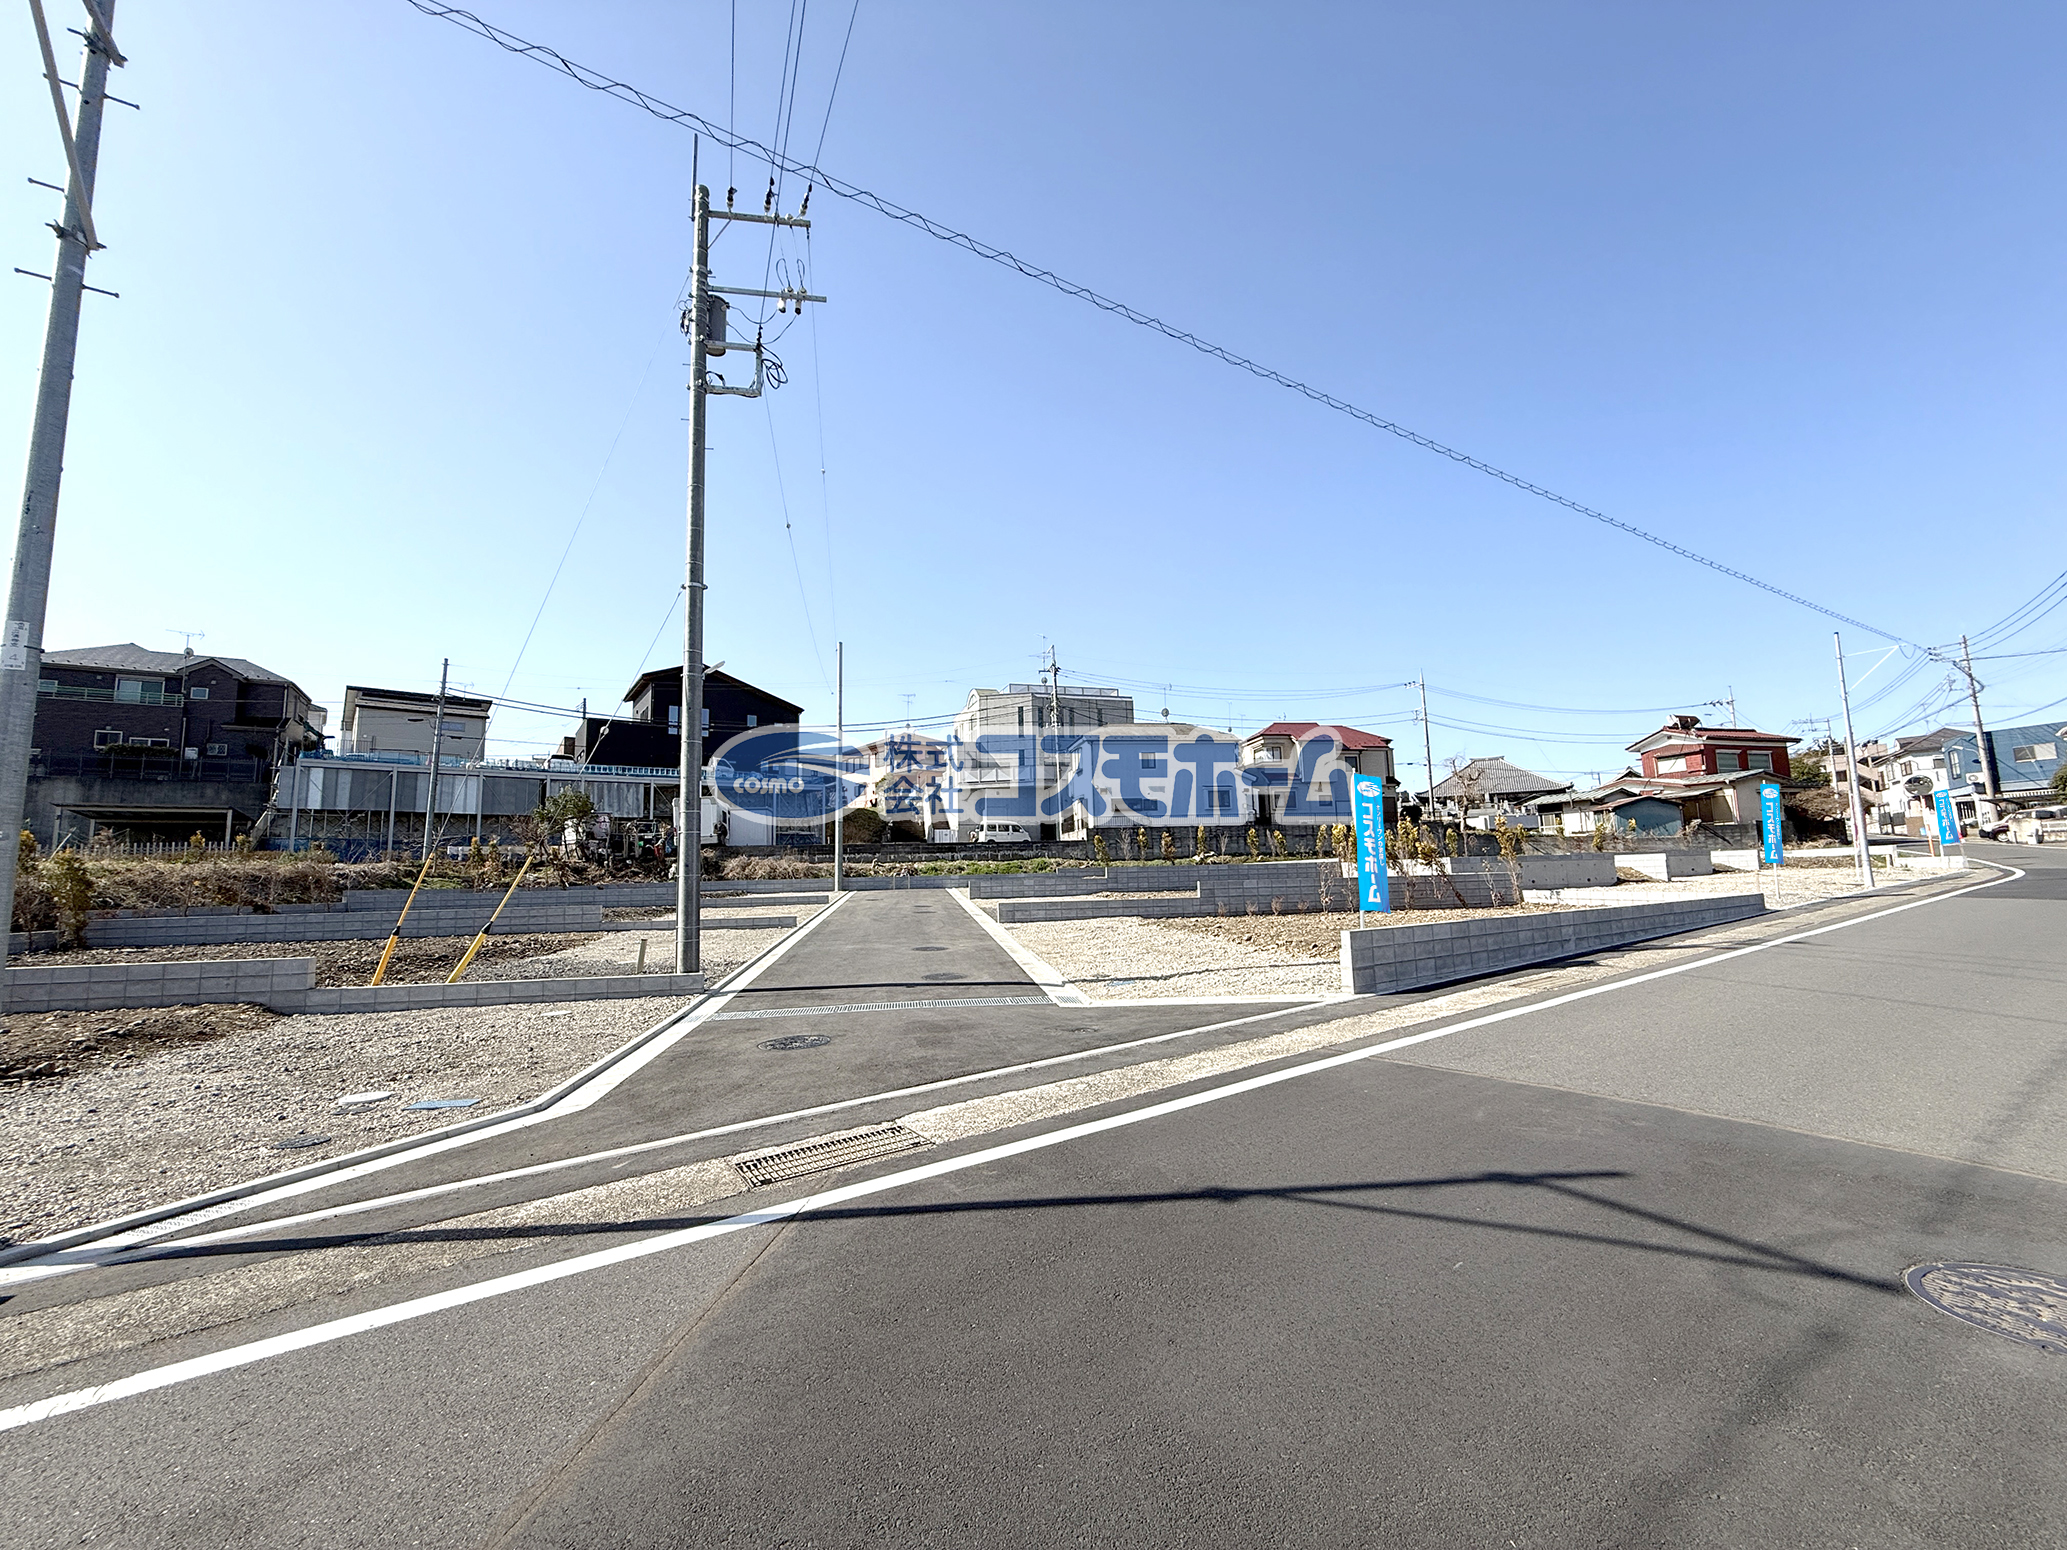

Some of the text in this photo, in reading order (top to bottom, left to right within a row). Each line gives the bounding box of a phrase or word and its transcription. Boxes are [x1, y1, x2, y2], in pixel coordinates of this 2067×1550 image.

[1361, 802, 1382, 903] コスモホーム
[1765, 802, 1778, 859] コスモホーム
